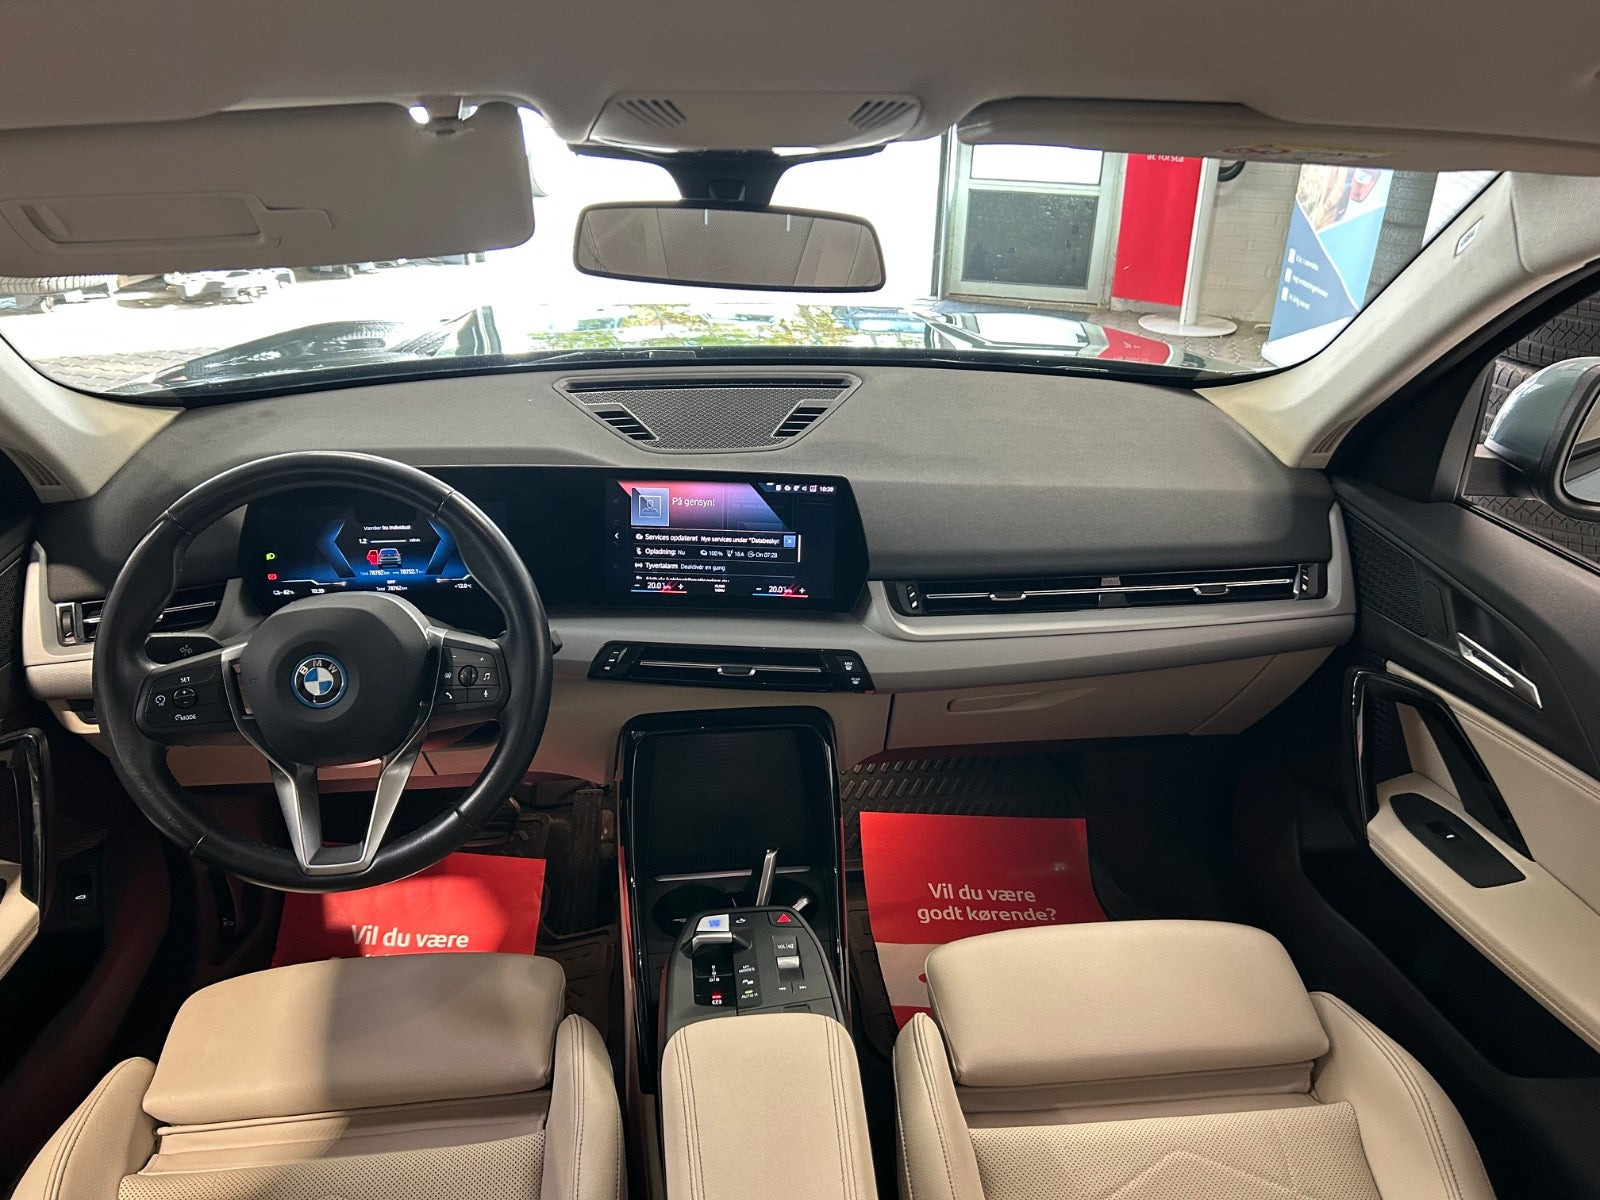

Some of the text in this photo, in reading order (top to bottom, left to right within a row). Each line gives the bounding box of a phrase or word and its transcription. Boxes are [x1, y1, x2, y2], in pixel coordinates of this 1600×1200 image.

[672, 497, 716, 508] På gensyn!
[644, 533, 669, 541] Services
[670, 535, 698, 544] opdateret
[645, 548, 676, 557] Opladning:
[299, 659, 338, 675] BMW
[928, 882, 1036, 902] Vil du være
[917, 906, 1057, 923] godt kørende?
[351, 924, 470, 948] Vil du være
